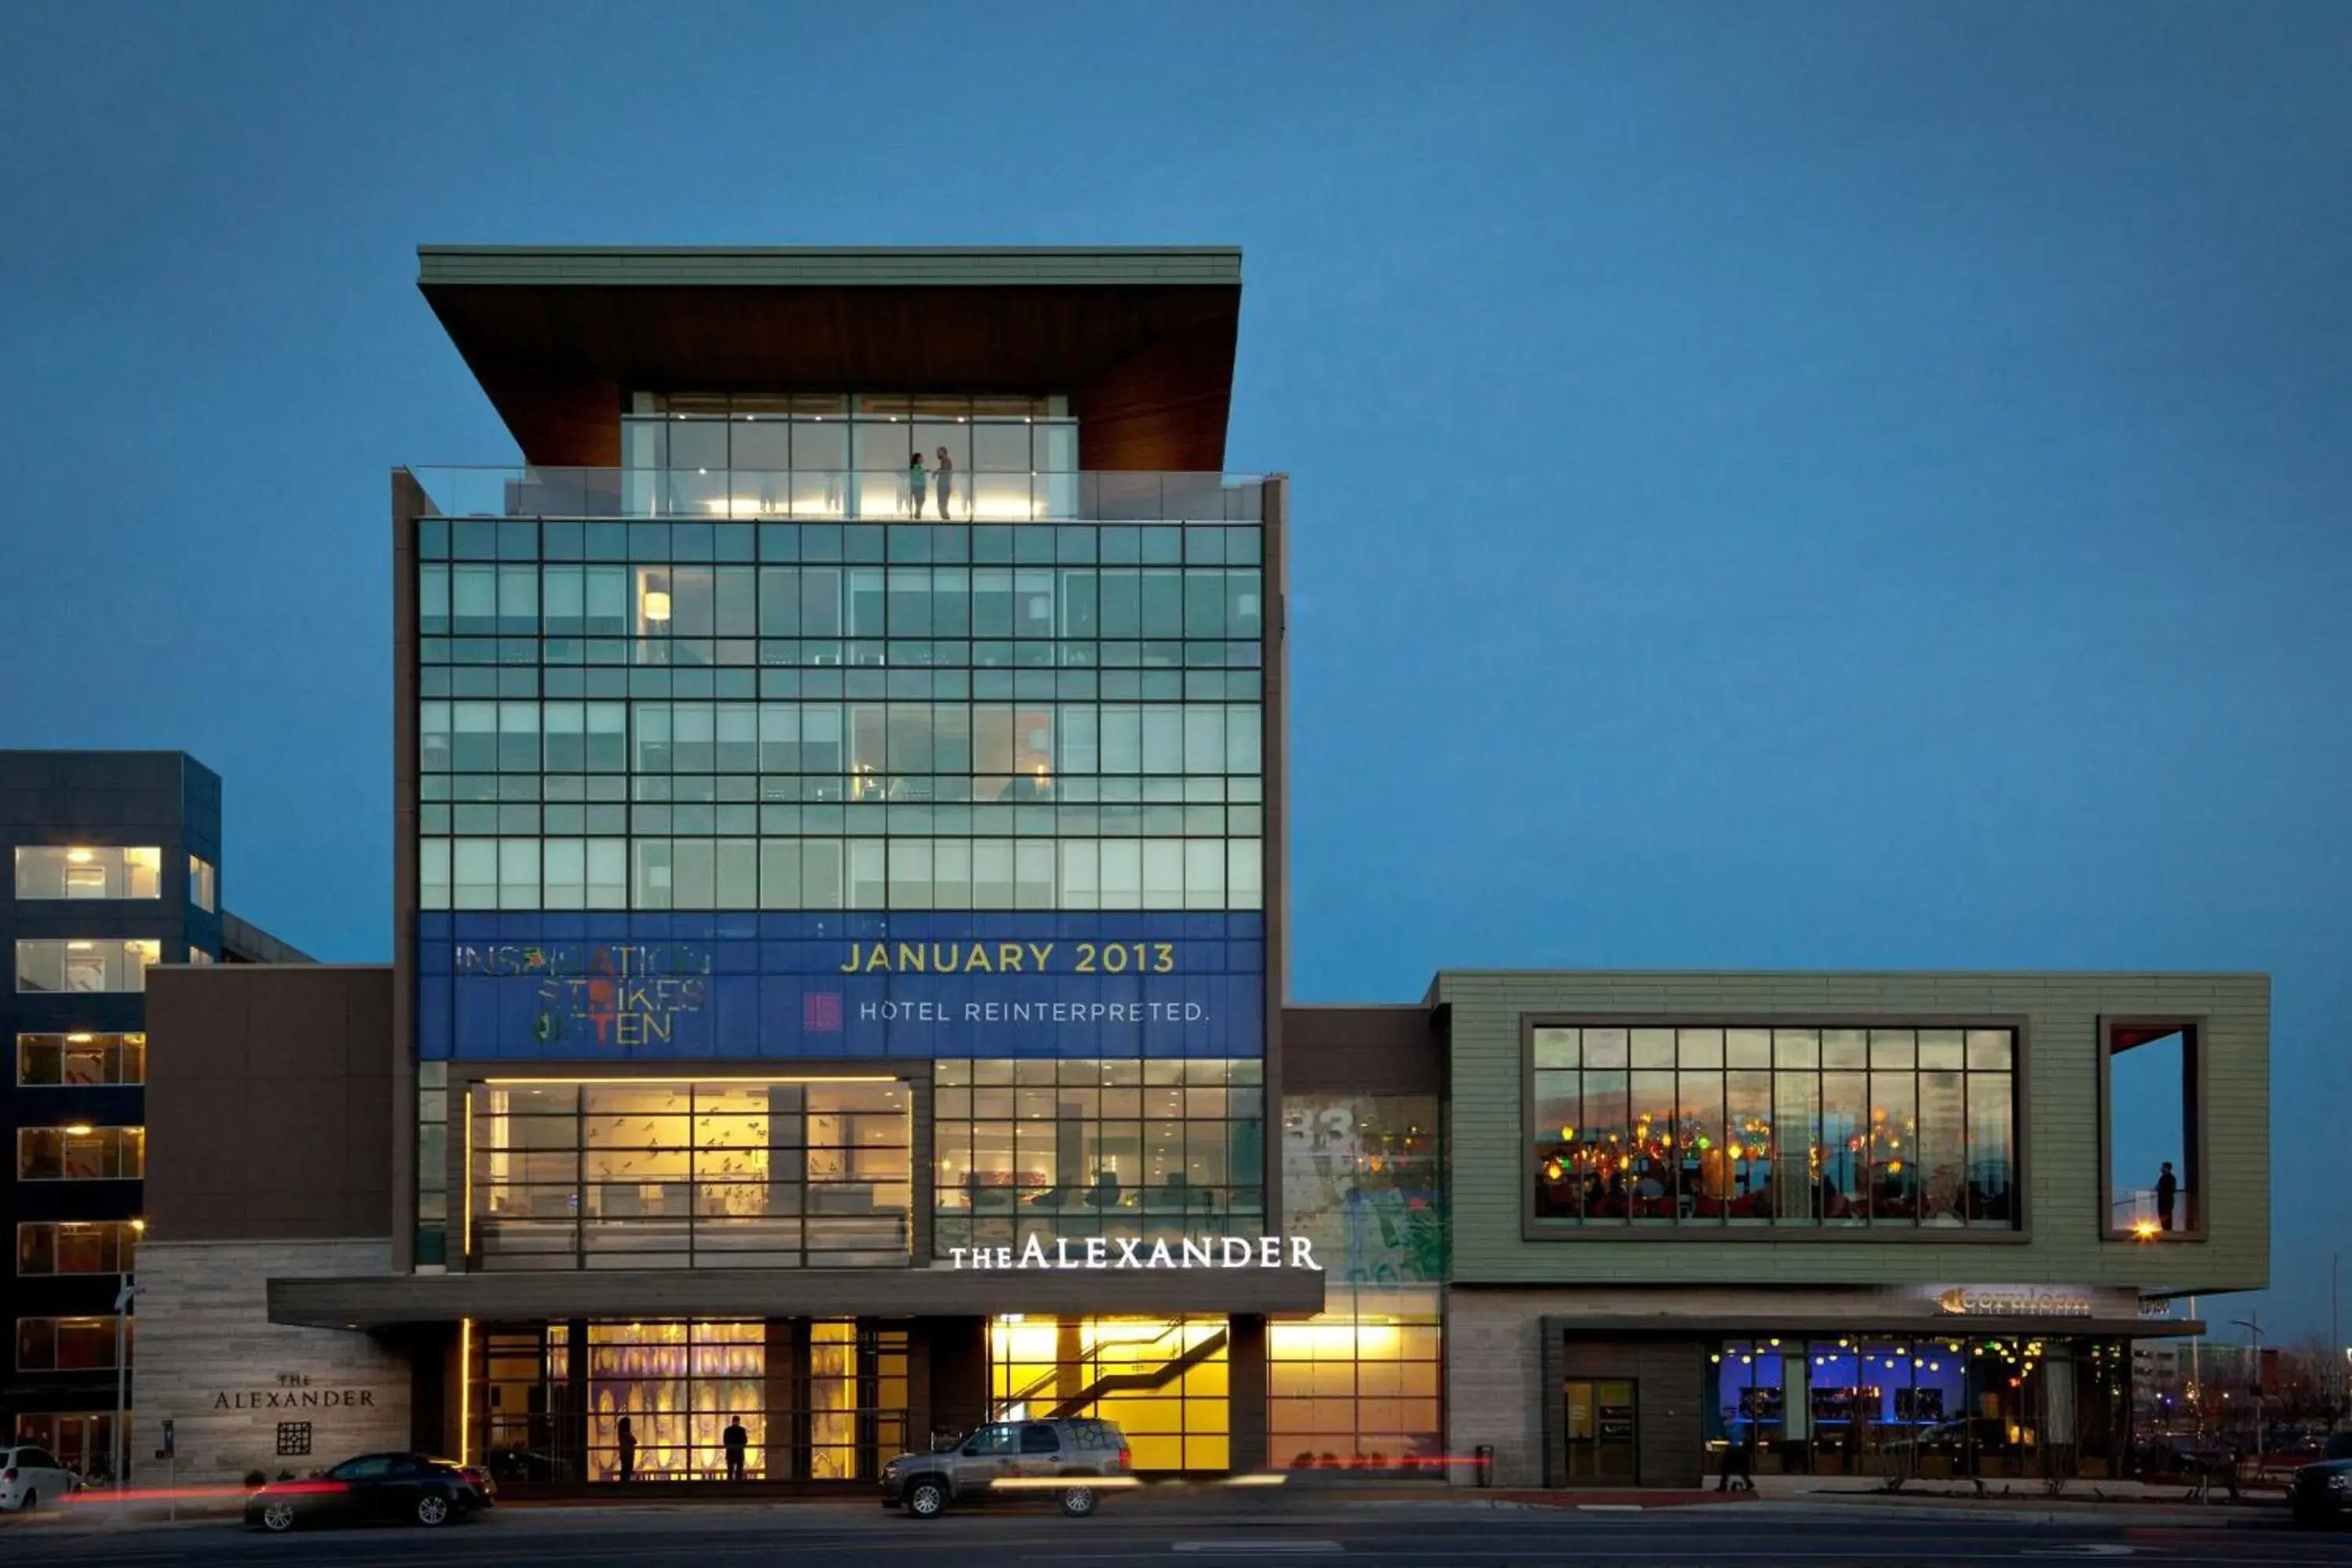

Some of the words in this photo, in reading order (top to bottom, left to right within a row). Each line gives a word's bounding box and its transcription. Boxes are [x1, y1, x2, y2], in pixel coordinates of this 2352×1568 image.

[841, 943, 1054, 973] JANUARY
[1075, 943, 1174, 973] 2013
[860, 1001, 949, 1022] HOTEL
[965, 1001, 1210, 1023] REINTERPRETED.
[949, 1247, 1012, 1269] THE
[1018, 1232, 1323, 1271] ALEXANDER
[278, 1374, 311, 1387] THE
[213, 1389, 376, 1410] ALEXANDER
